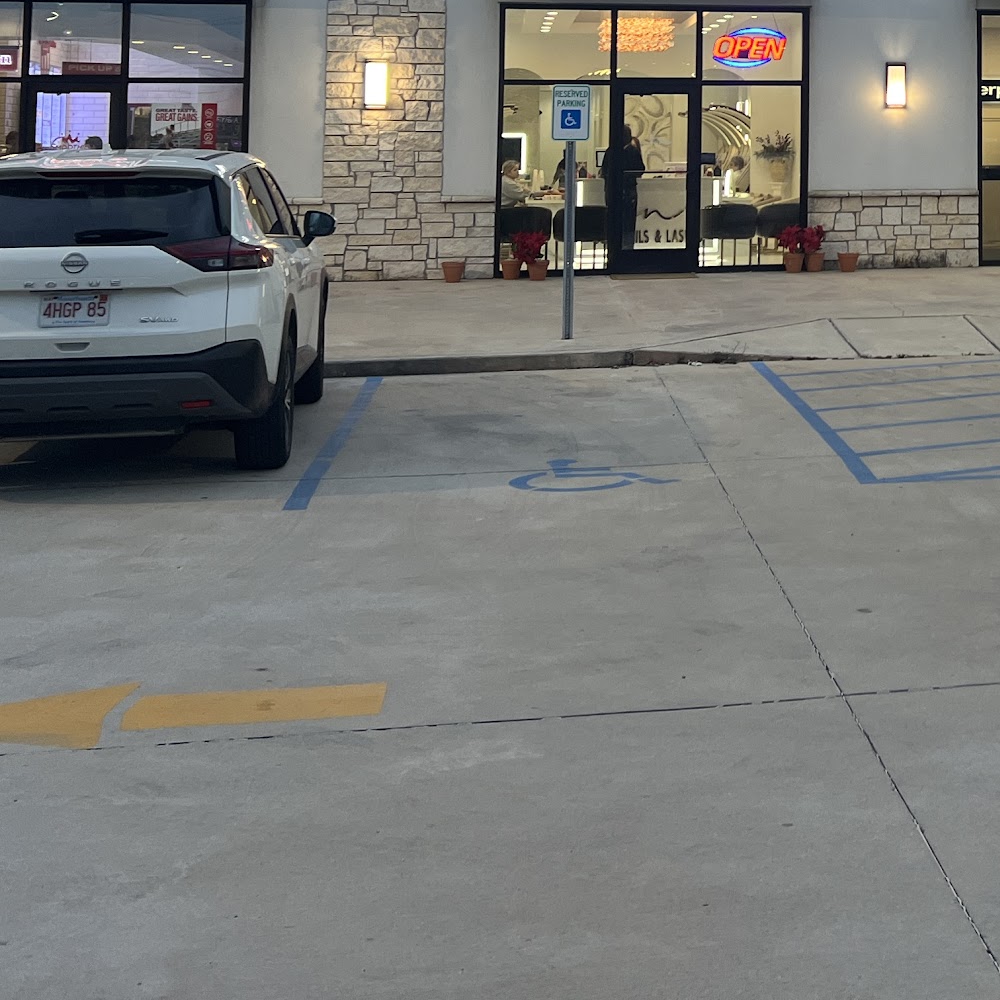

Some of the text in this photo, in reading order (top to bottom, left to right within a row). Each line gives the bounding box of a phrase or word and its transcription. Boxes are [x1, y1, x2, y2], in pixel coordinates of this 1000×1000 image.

[712, 35, 787, 61] OPEN
[68, 64, 95, 72] PICK
[97, 64, 112, 72] UP
[555, 90, 588, 98] RESERVED
[155, 113, 176, 122] GREAT
[655, 230, 663, 244] &
[23, 280, 121, 289] ROGUE
[43, 302, 106, 319] 4HGP 85
